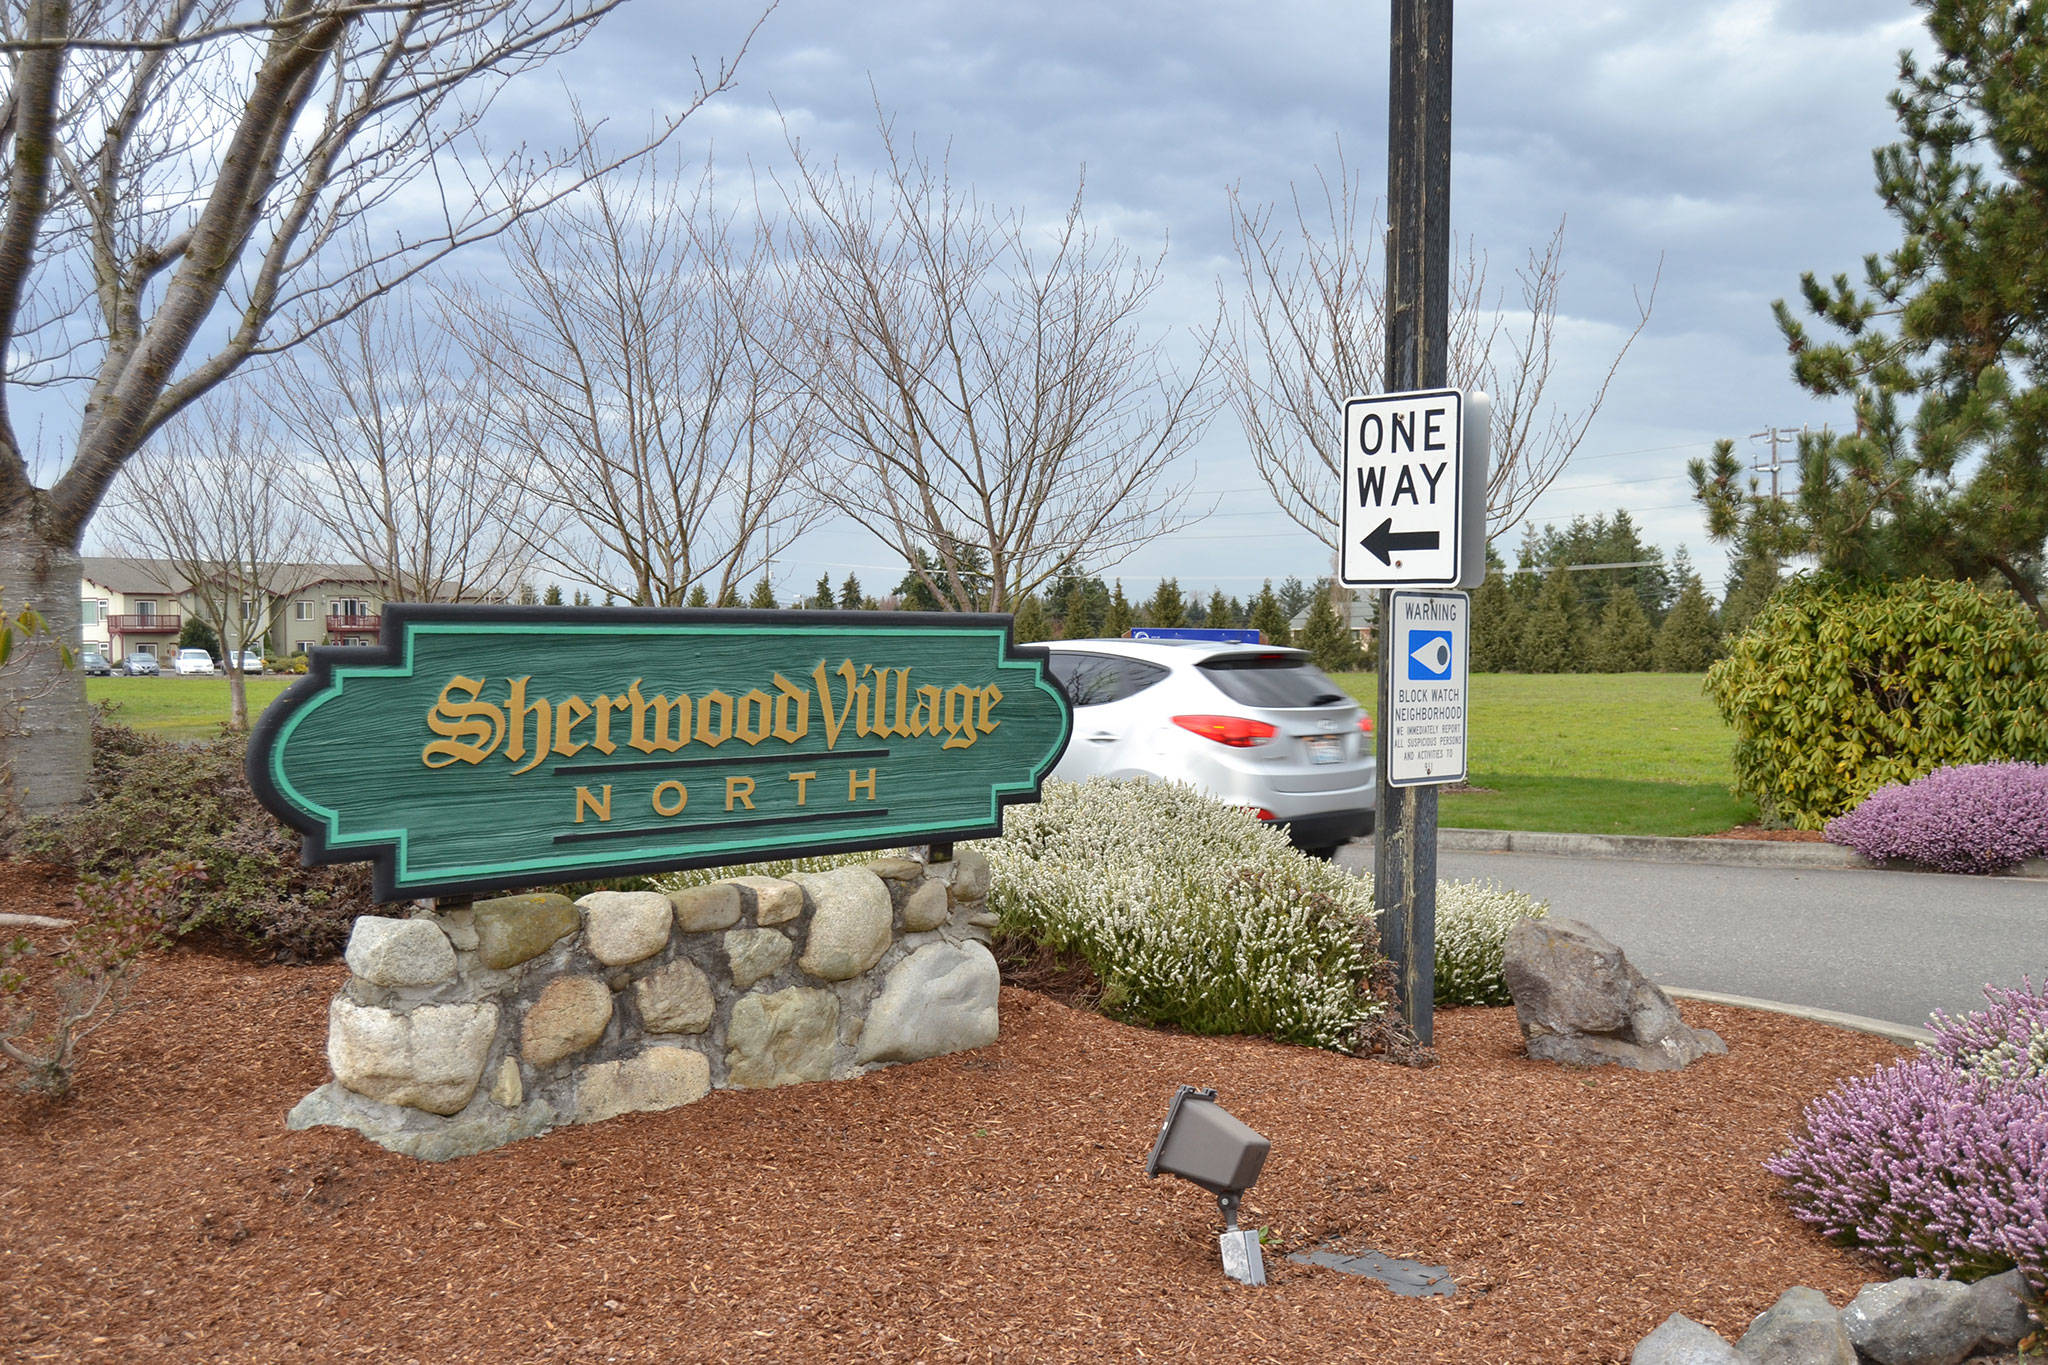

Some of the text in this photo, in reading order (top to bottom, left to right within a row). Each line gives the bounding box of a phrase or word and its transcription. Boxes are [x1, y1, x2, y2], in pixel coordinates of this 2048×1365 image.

[1359, 408, 1446, 456] ONE
[1357, 461, 1447, 508] WAY
[1405, 602, 1457, 621] WARNING
[1399, 688, 1460, 703] BLOCK WATCH
[422, 657, 1005, 775] Sherwood Village
[1395, 706, 1462, 721] NEIGHBORHOOD
[1396, 723, 1460, 736] WE IMMEDIATELY REPORT
[1394, 736, 1462, 748] ALL SUSPICIOUS PERSONS
[1404, 749, 1453, 760] AND ACTIVITIES TO
[575, 768, 878, 823] NORTH
